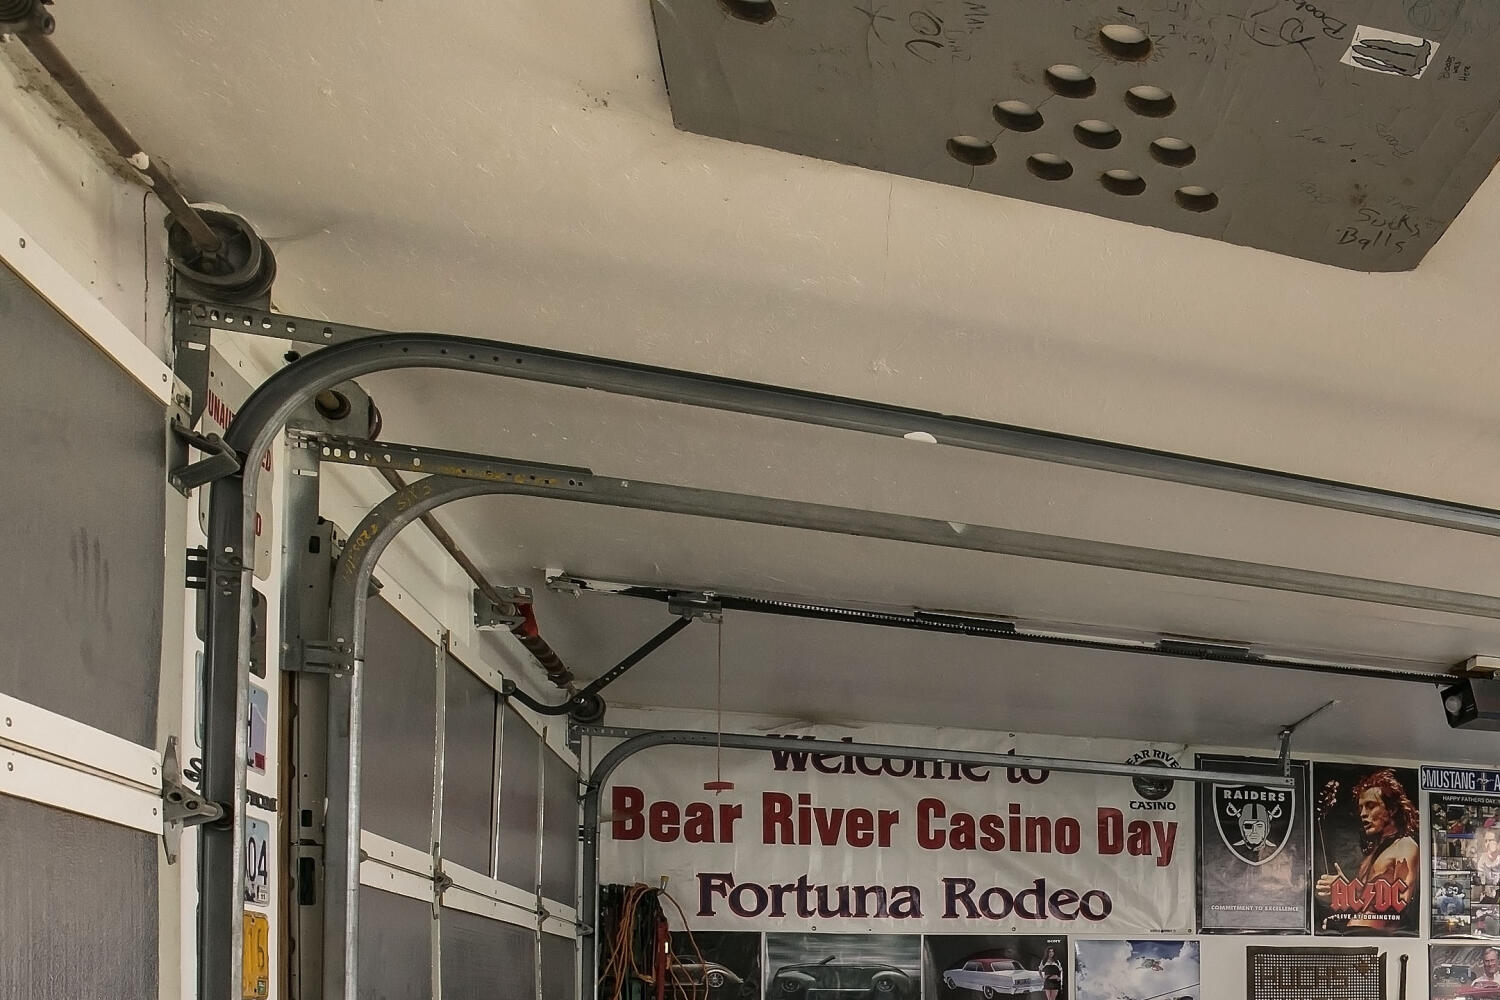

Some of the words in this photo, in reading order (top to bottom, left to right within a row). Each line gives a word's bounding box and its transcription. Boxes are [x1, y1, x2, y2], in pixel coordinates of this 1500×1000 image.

[766, 733, 991, 783] Welcome
[1223, 789, 1285, 801] RAIDERS
[1426, 769, 1476, 790] MUSTANG
[1129, 801, 1176, 811] CASINO
[611, 786, 742, 844] Bear
[762, 791, 899, 848] River
[916, 797, 1081, 854] Casino
[1097, 807, 1178, 867] Day
[696, 871, 923, 919] Fortuna
[942, 876, 1113, 921] Rodeo
[1330, 876, 1408, 913] AC/DC
